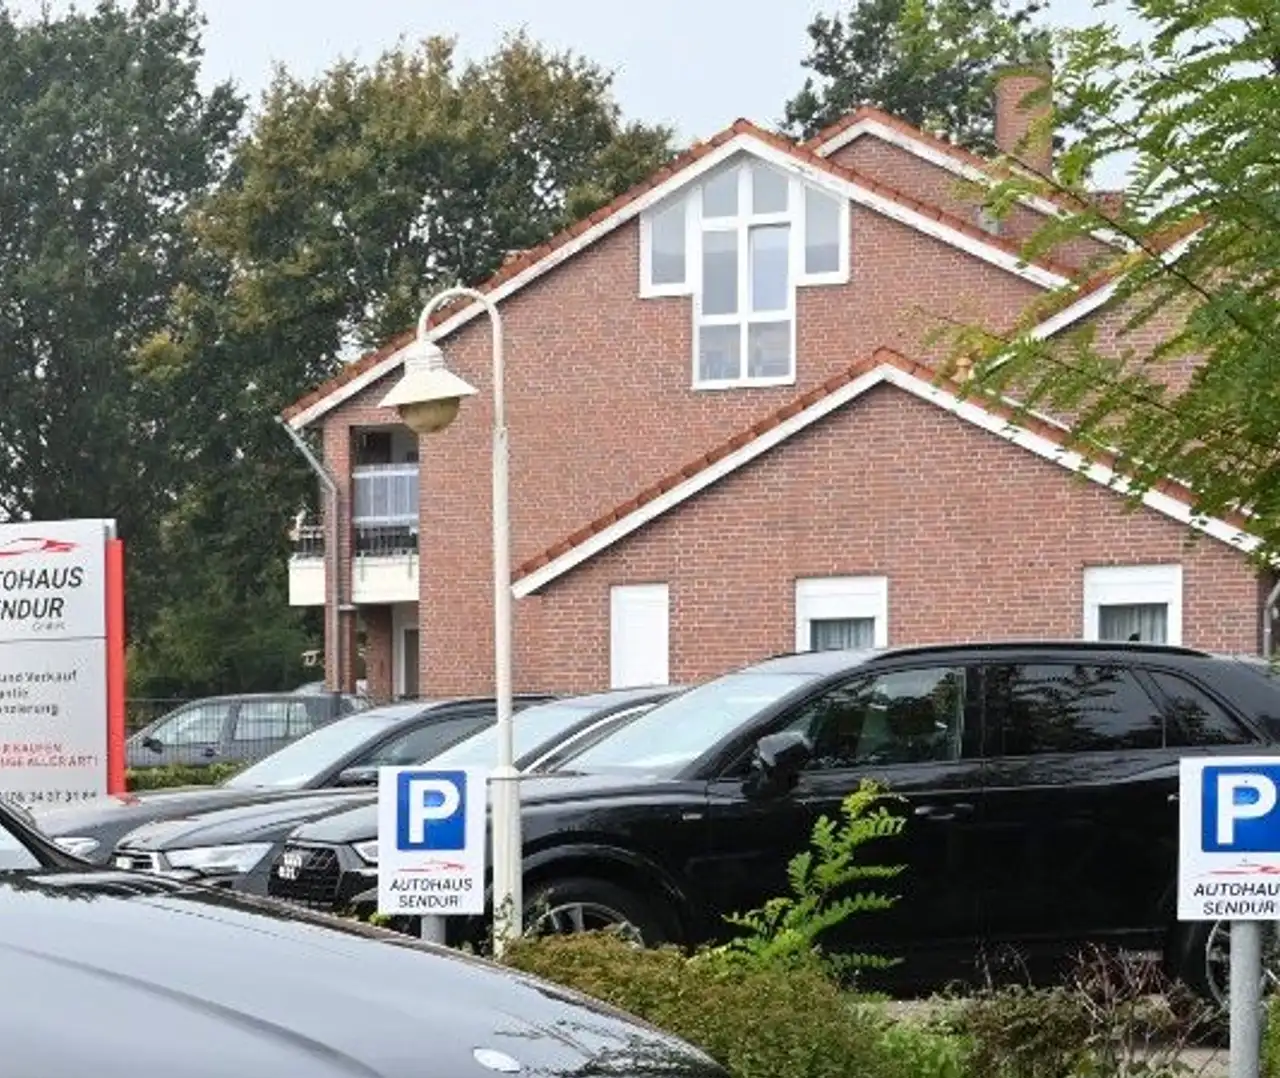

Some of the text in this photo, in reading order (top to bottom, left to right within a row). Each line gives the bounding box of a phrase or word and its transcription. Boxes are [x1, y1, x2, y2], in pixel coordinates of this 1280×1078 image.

[390, 878, 473, 892] AUTOHAUS
[1193, 882, 1280, 897] AUTOHAU
[399, 895, 458, 909] SENDUR
[1203, 900, 1275, 916] SENDUR
